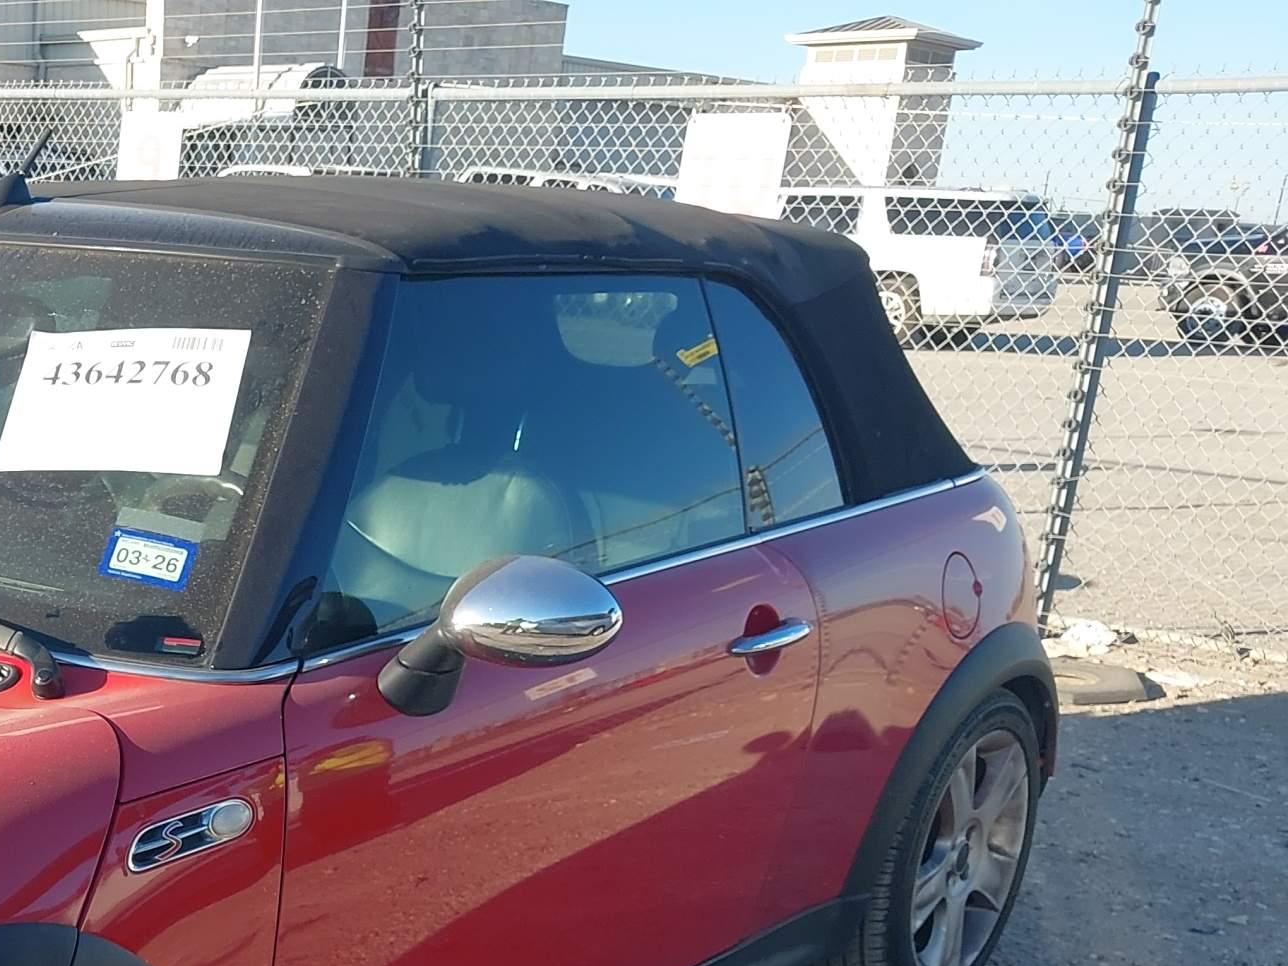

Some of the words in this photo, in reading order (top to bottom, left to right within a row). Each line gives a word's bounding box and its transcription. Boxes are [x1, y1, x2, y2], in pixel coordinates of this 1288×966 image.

[43, 360, 214, 387] 43642768
[116, 547, 142, 566] 03
[151, 554, 180, 574] 26
[154, 819, 184, 861] S
